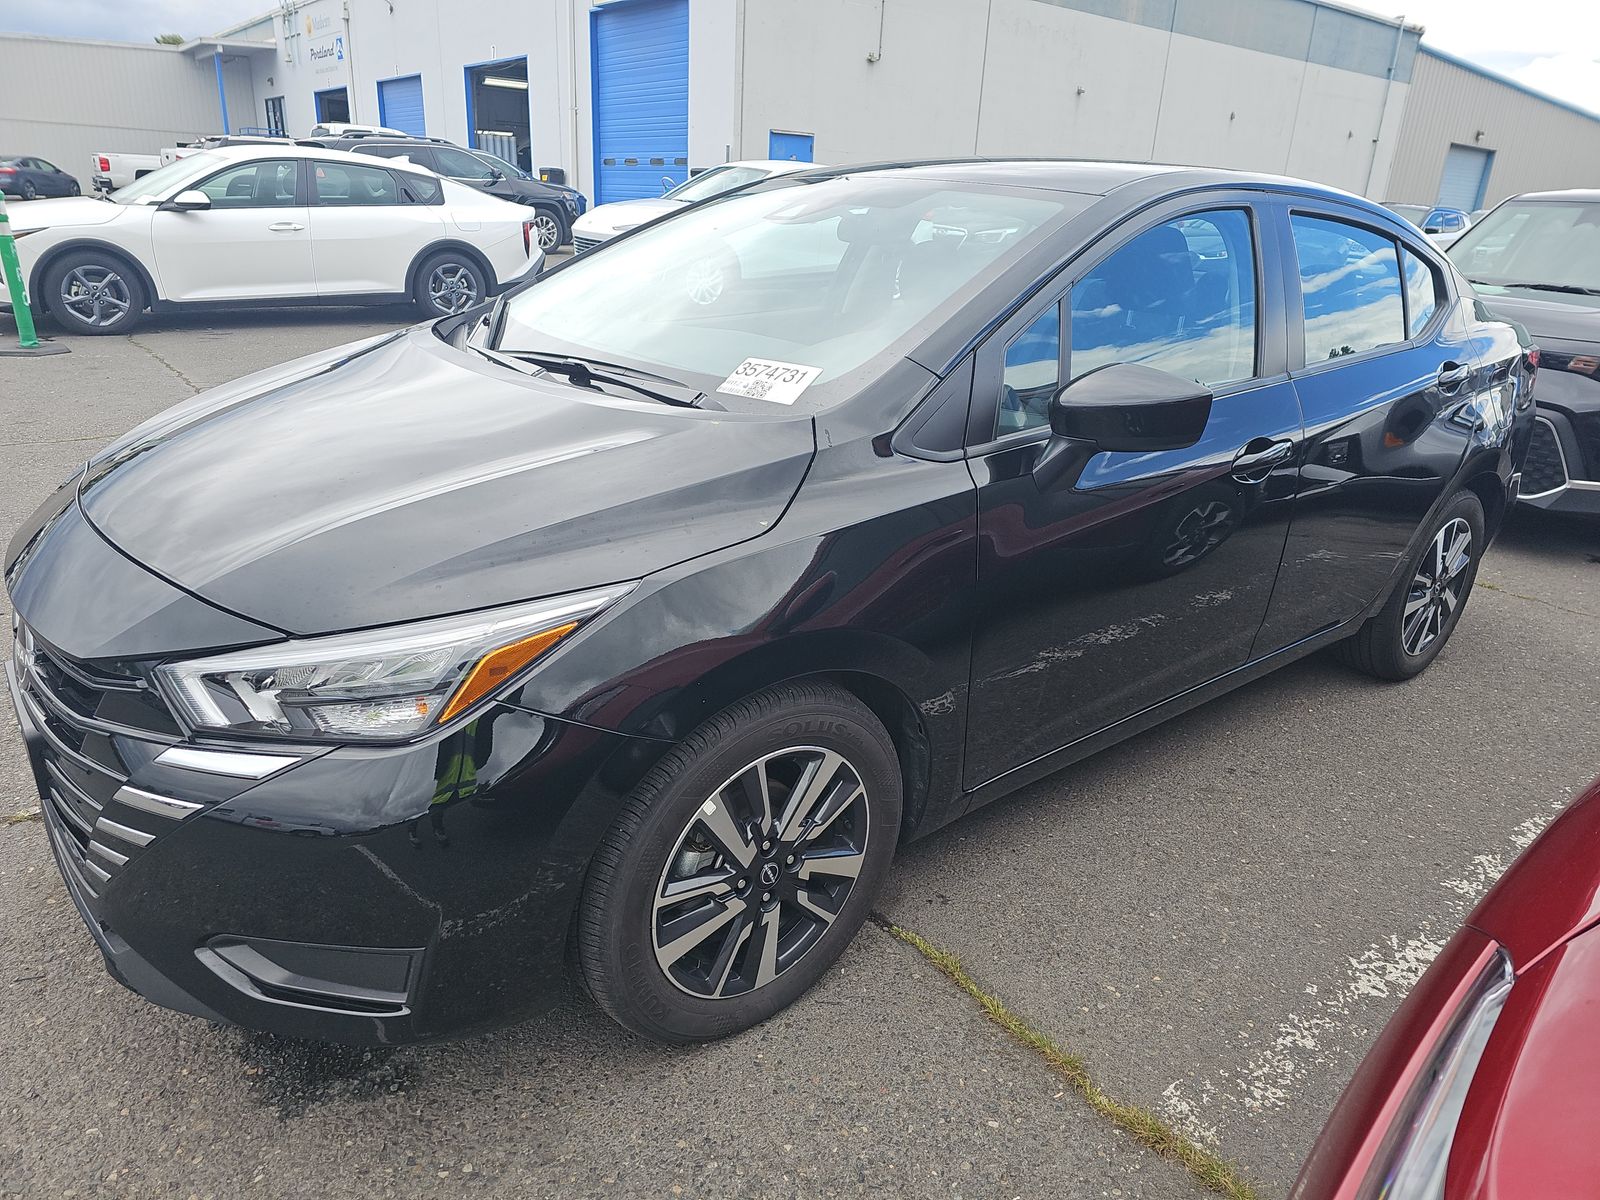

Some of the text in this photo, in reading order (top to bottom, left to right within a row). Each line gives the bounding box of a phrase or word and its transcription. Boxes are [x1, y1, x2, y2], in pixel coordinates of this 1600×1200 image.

[310, 42, 335, 61] Portland
[735, 362, 808, 384] 3574731
[767, 720, 848, 742] SOLUS
